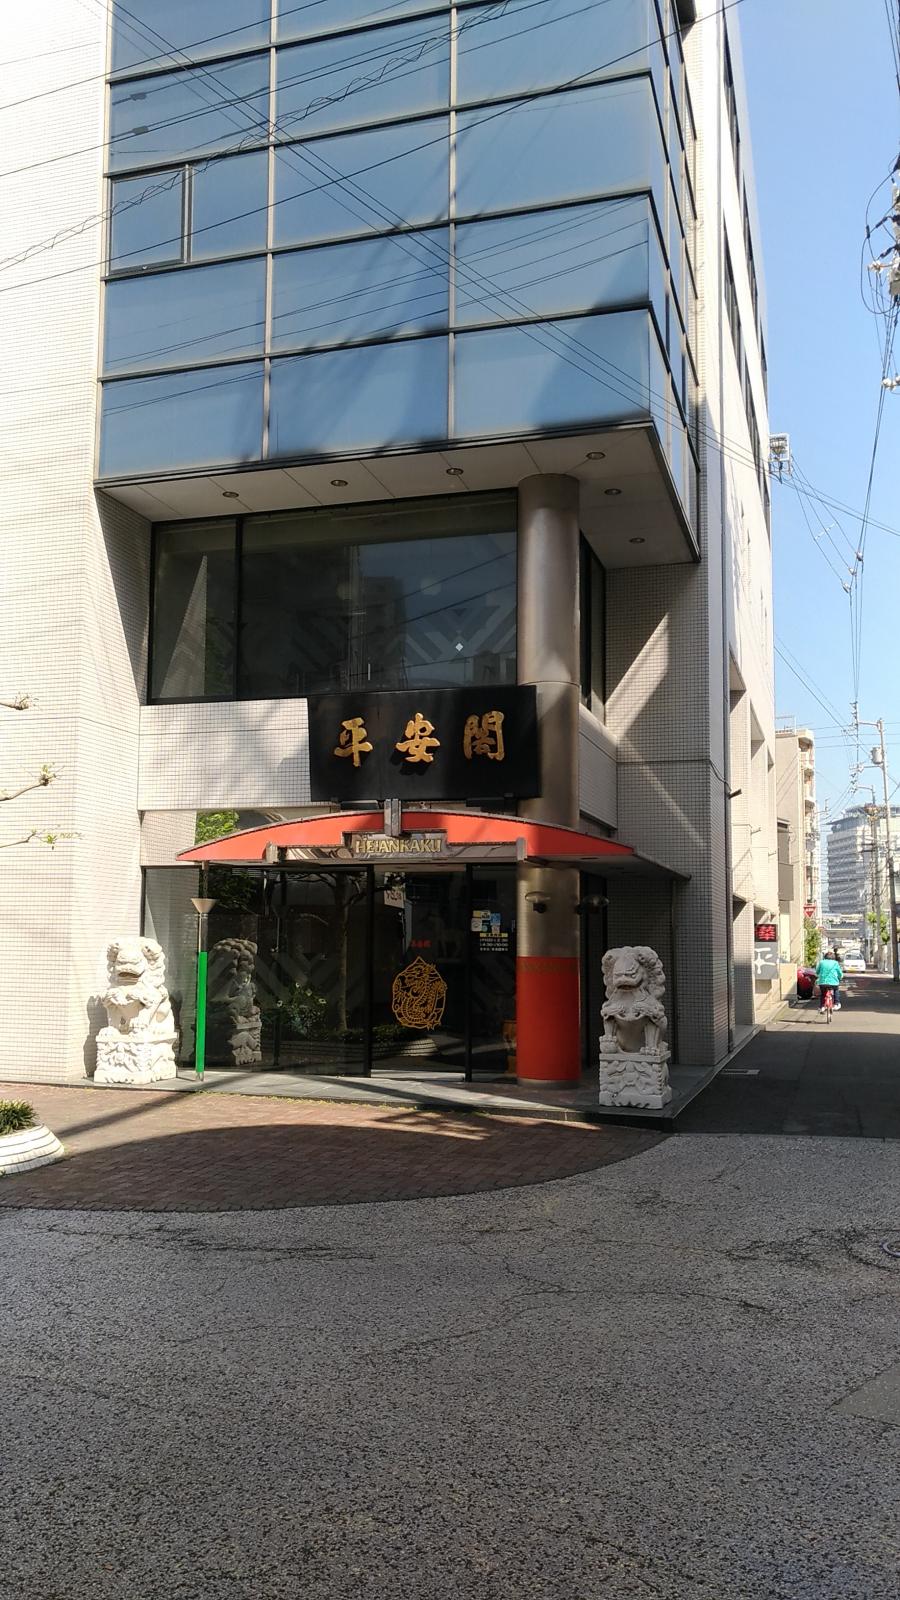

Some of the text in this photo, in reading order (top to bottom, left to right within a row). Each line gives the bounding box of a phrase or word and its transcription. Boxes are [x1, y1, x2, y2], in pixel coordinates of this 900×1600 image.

[333, 710, 505, 767] 平安閣
[355, 838, 442, 854] HEIANKAKU
